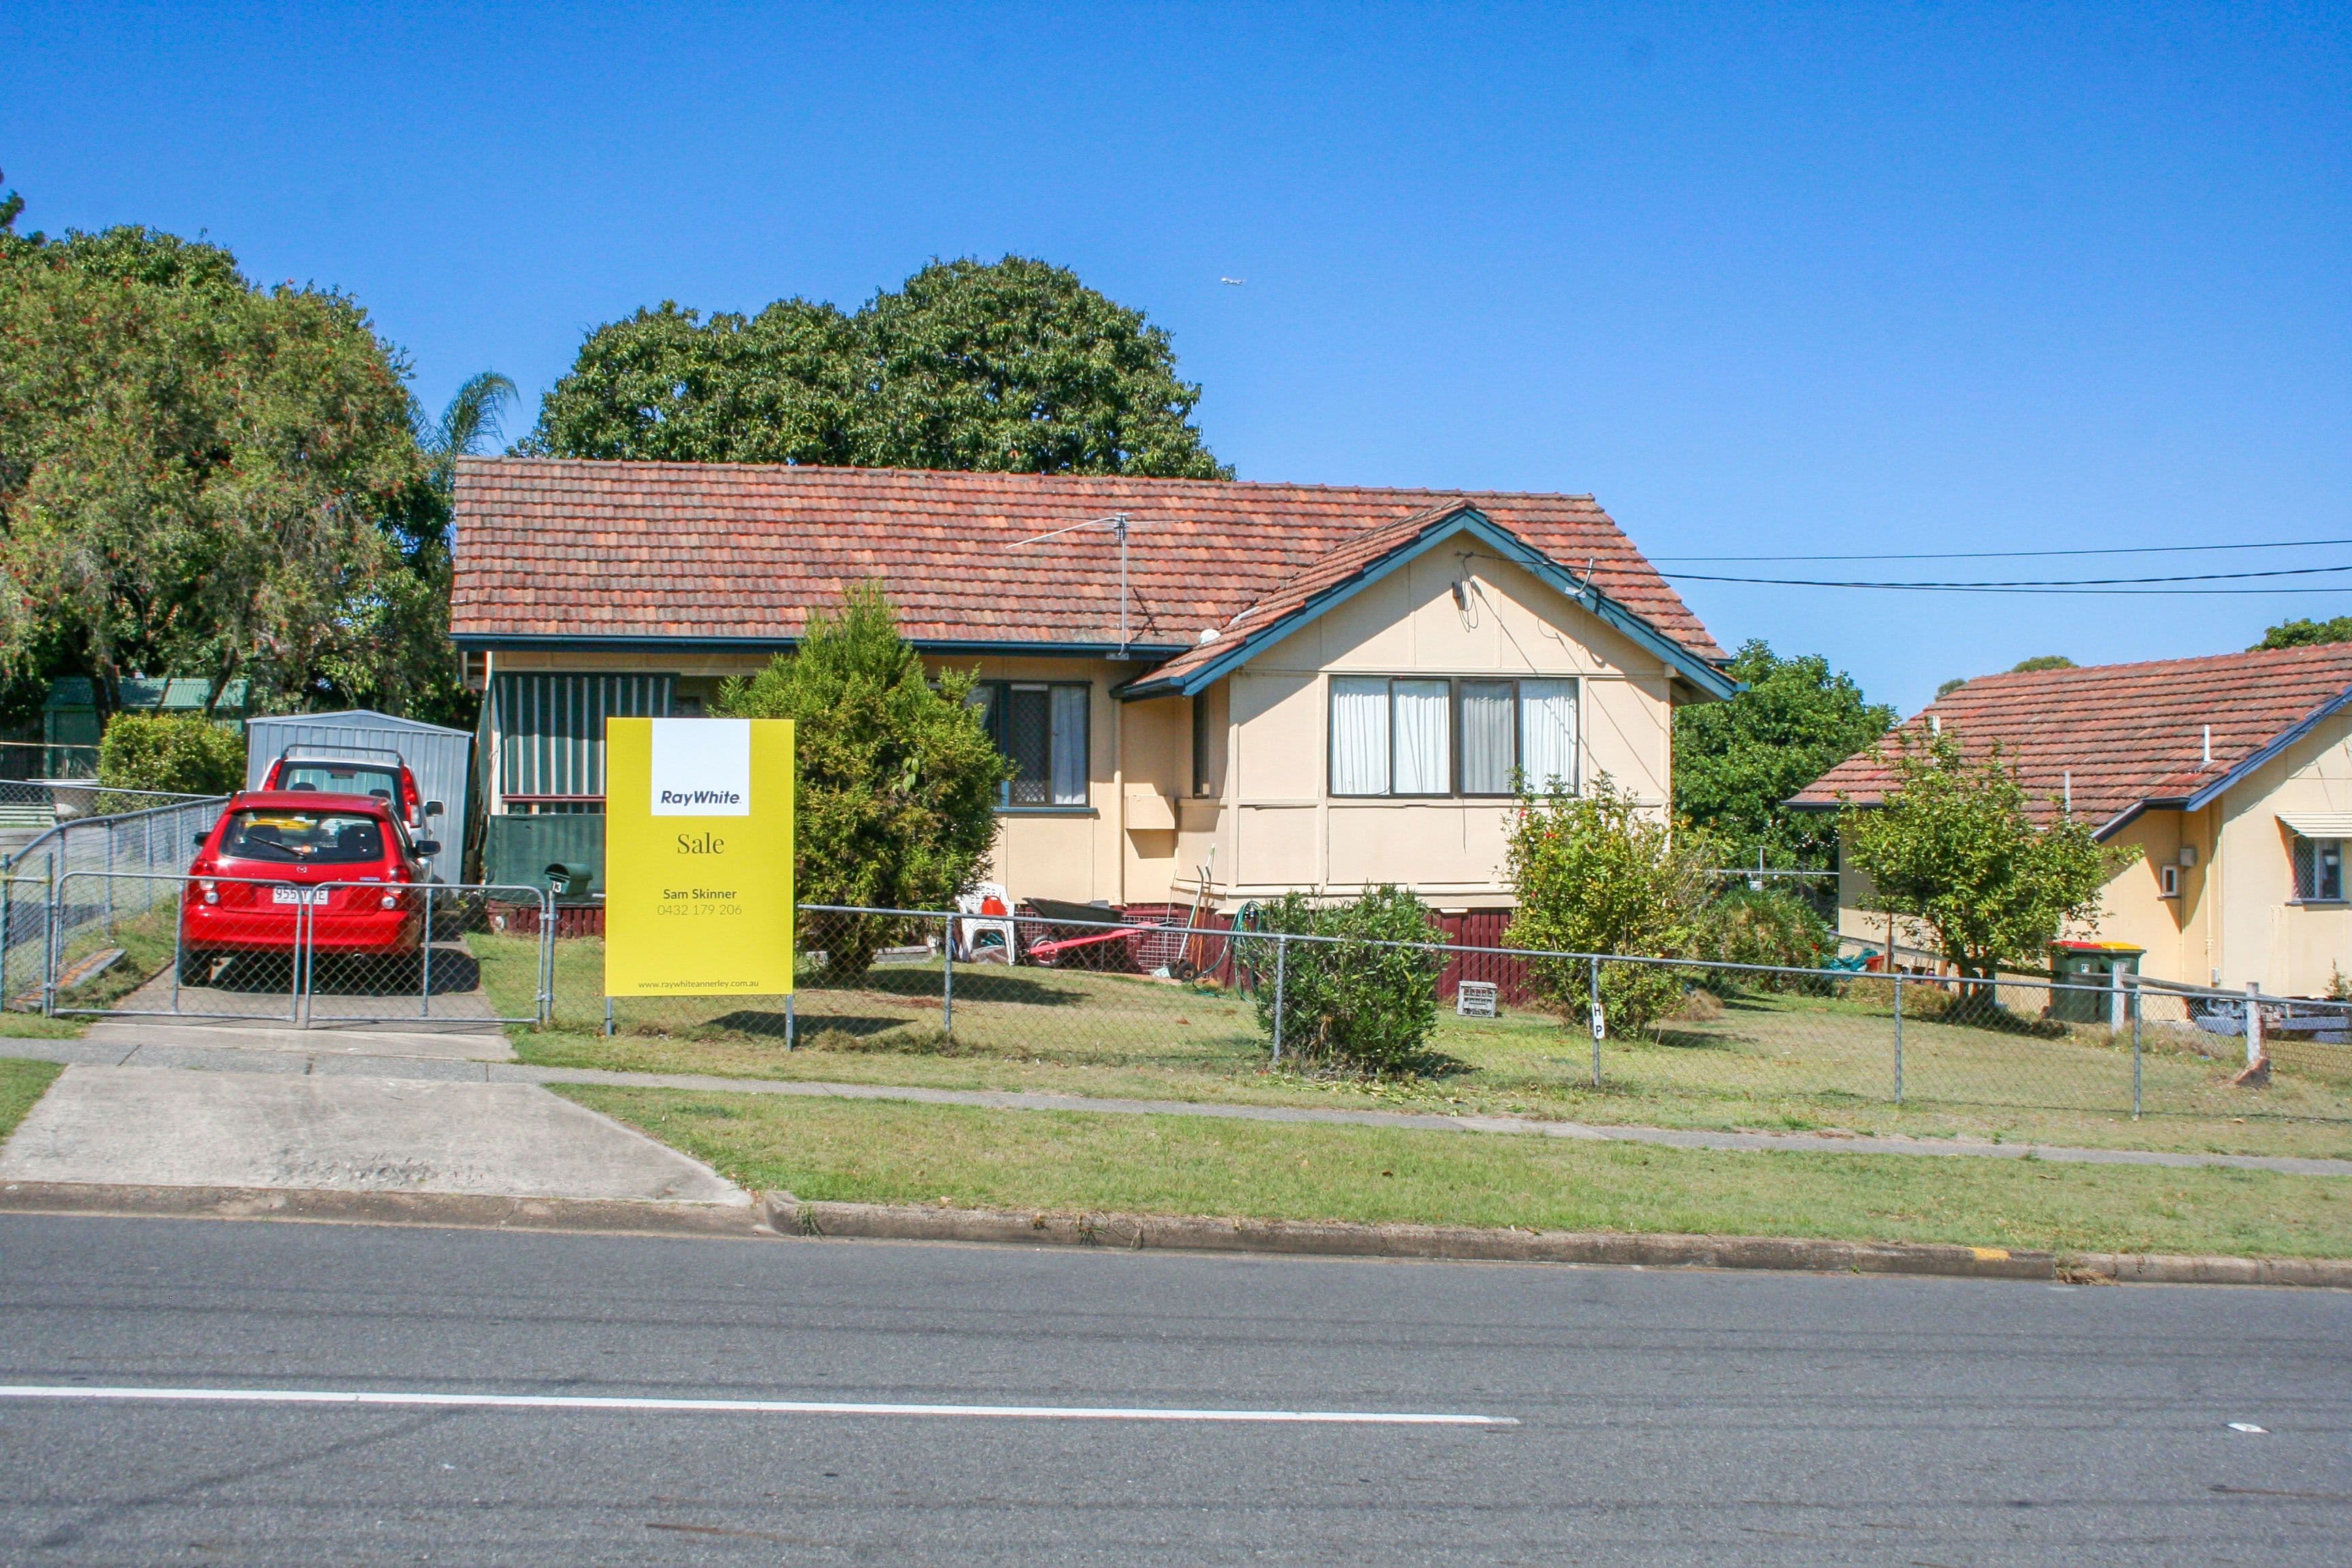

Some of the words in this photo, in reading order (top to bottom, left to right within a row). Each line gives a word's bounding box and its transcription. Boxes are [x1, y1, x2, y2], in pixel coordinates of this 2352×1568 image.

[677, 832, 725, 854] Sale
[552, 881, 562, 893] 13
[663, 889, 689, 900] Sam
[691, 889, 737, 900] Skinner
[657, 904, 688, 915] 0432
[693, 904, 715, 915] 179
[719, 904, 742, 915] 206
[638, 980, 759, 990] www.raywhiteannerley.com.au
